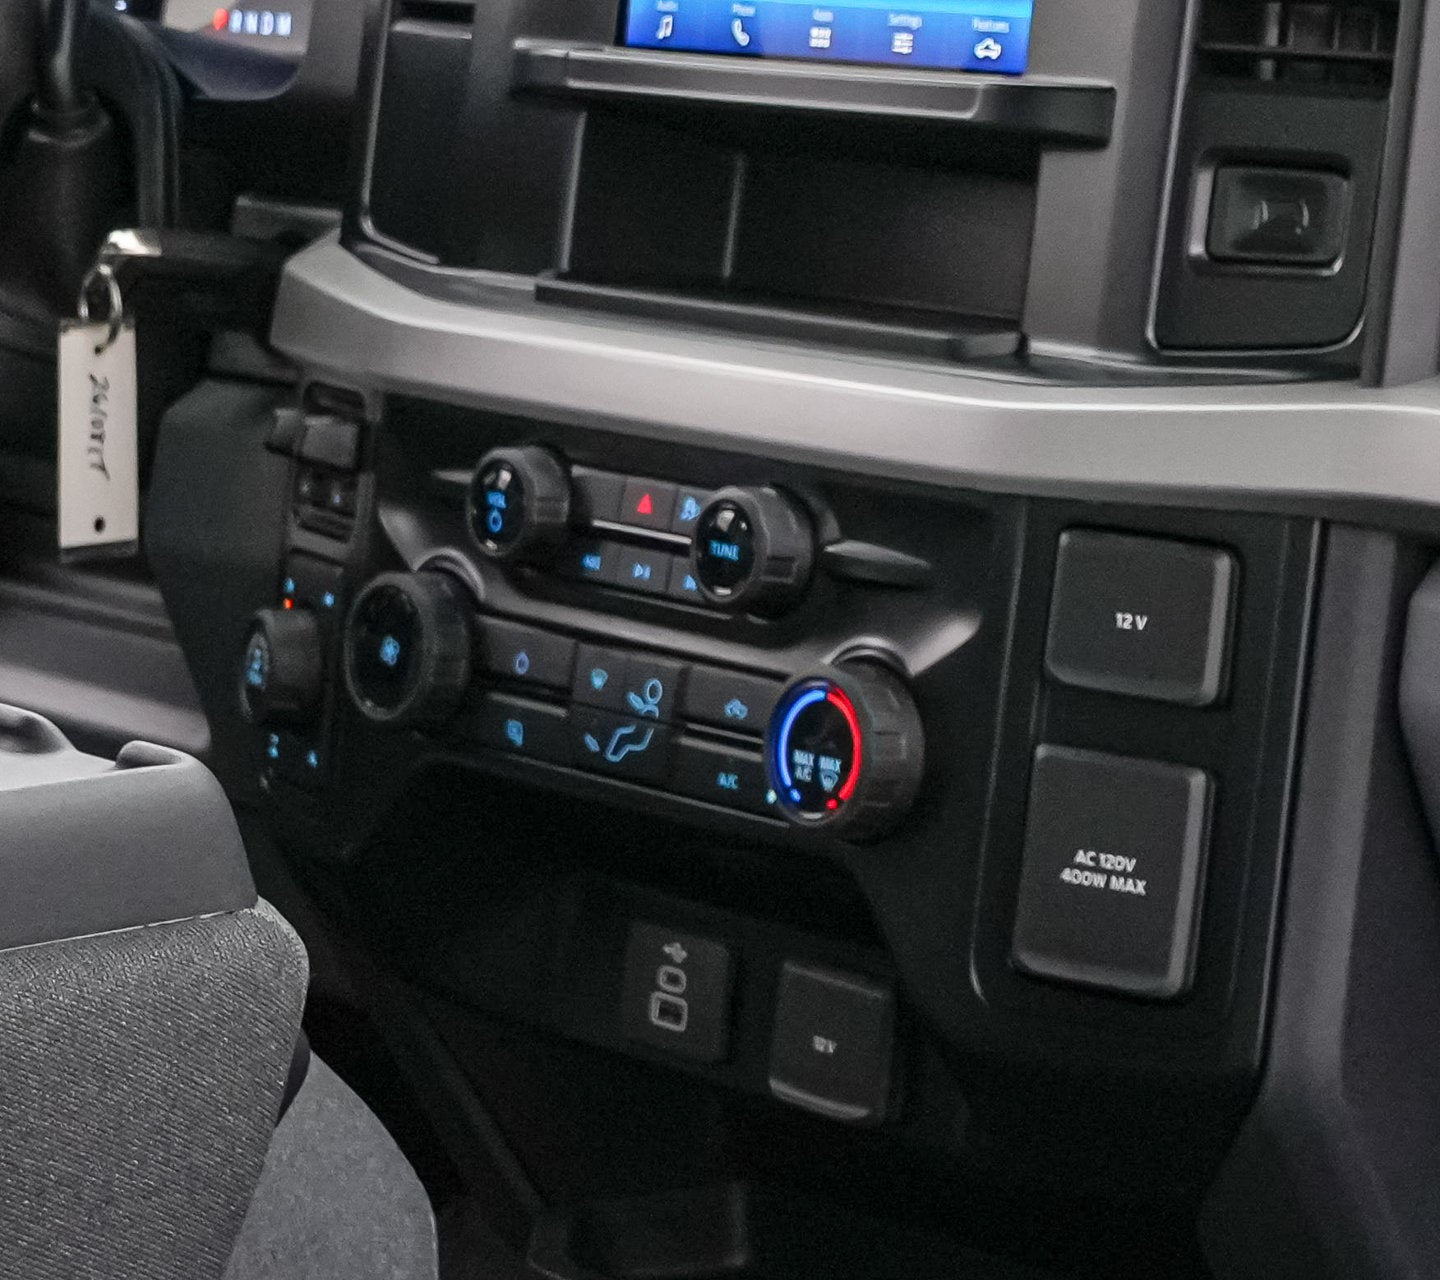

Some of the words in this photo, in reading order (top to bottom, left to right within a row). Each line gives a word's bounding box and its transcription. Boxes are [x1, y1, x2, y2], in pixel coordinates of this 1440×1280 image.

[709, 540, 740, 562] TUNE
[1115, 612, 1133, 629] 12
[1134, 615, 1148, 631] V
[1073, 850, 1097, 866] AC
[1099, 853, 1137, 873] 120V
[1060, 867, 1107, 889] 400W
[1109, 874, 1147, 896] MAX
